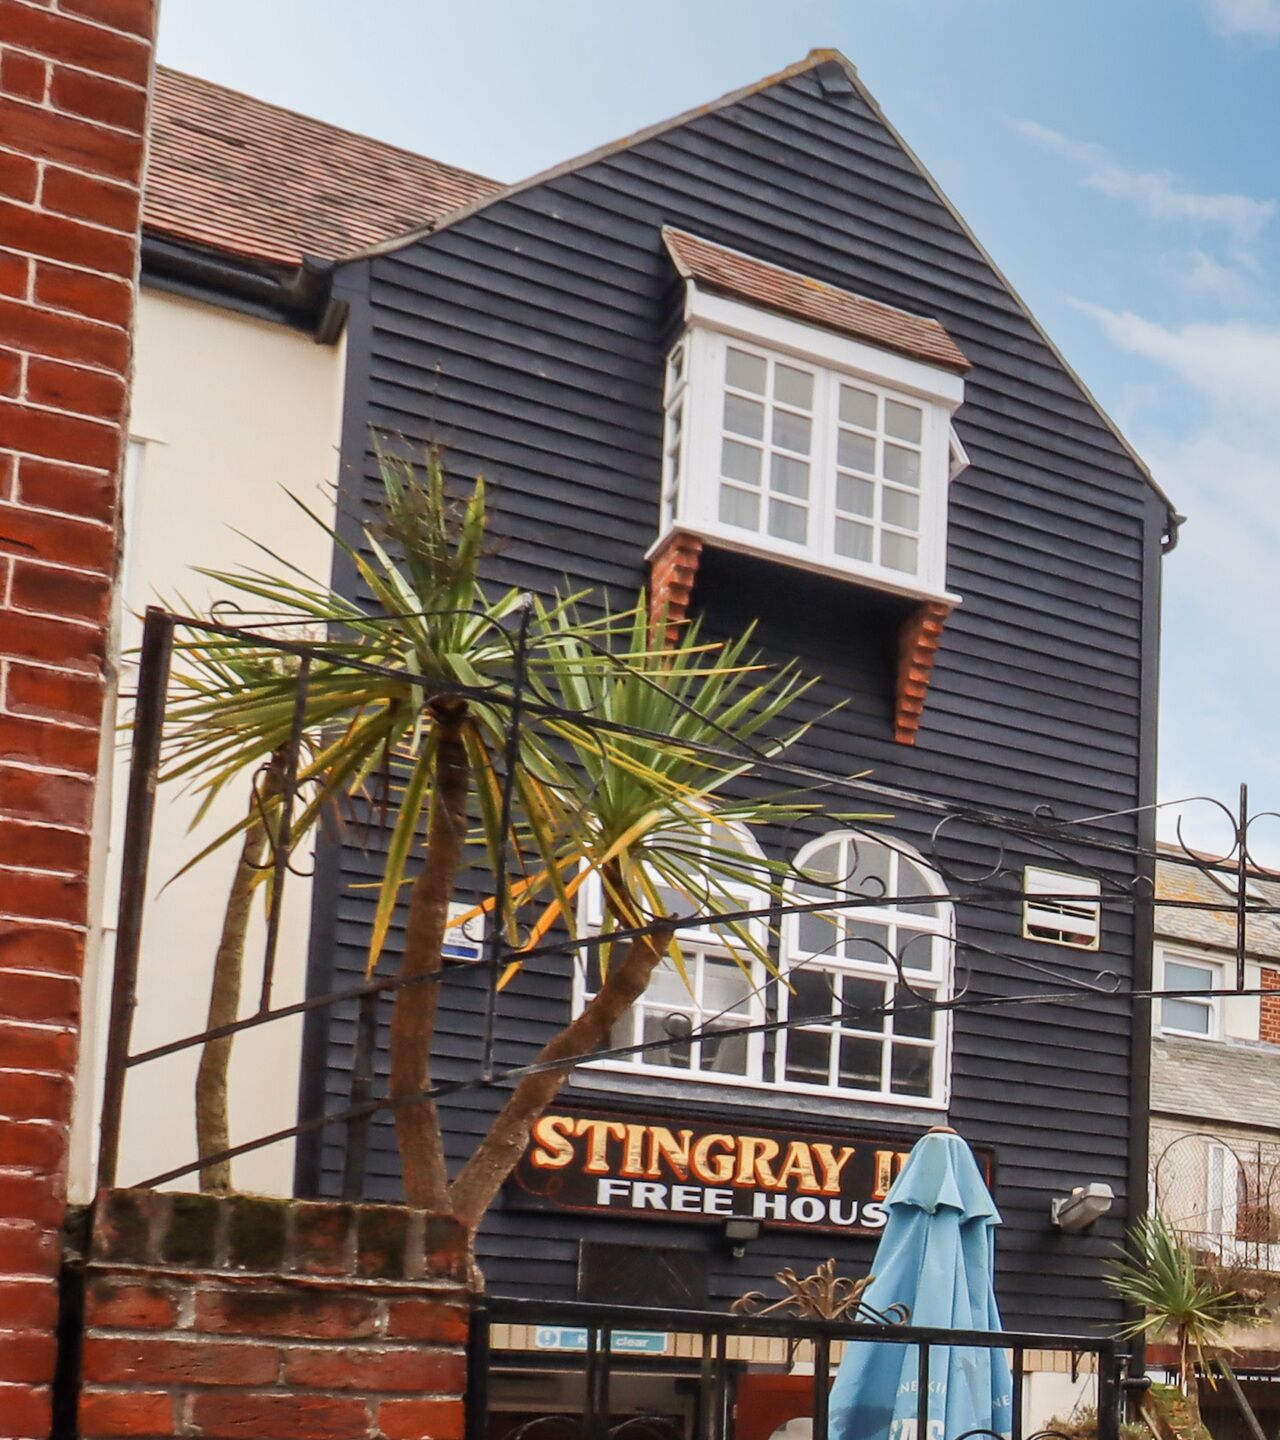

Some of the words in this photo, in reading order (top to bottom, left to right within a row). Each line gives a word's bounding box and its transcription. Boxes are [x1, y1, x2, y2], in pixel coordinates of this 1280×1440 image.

[531, 1115, 855, 1193] STINGRAY
[597, 1178, 734, 1215] FREE
[753, 1192, 887, 1228] HOUS
[615, 1336, 649, 1347] clear
